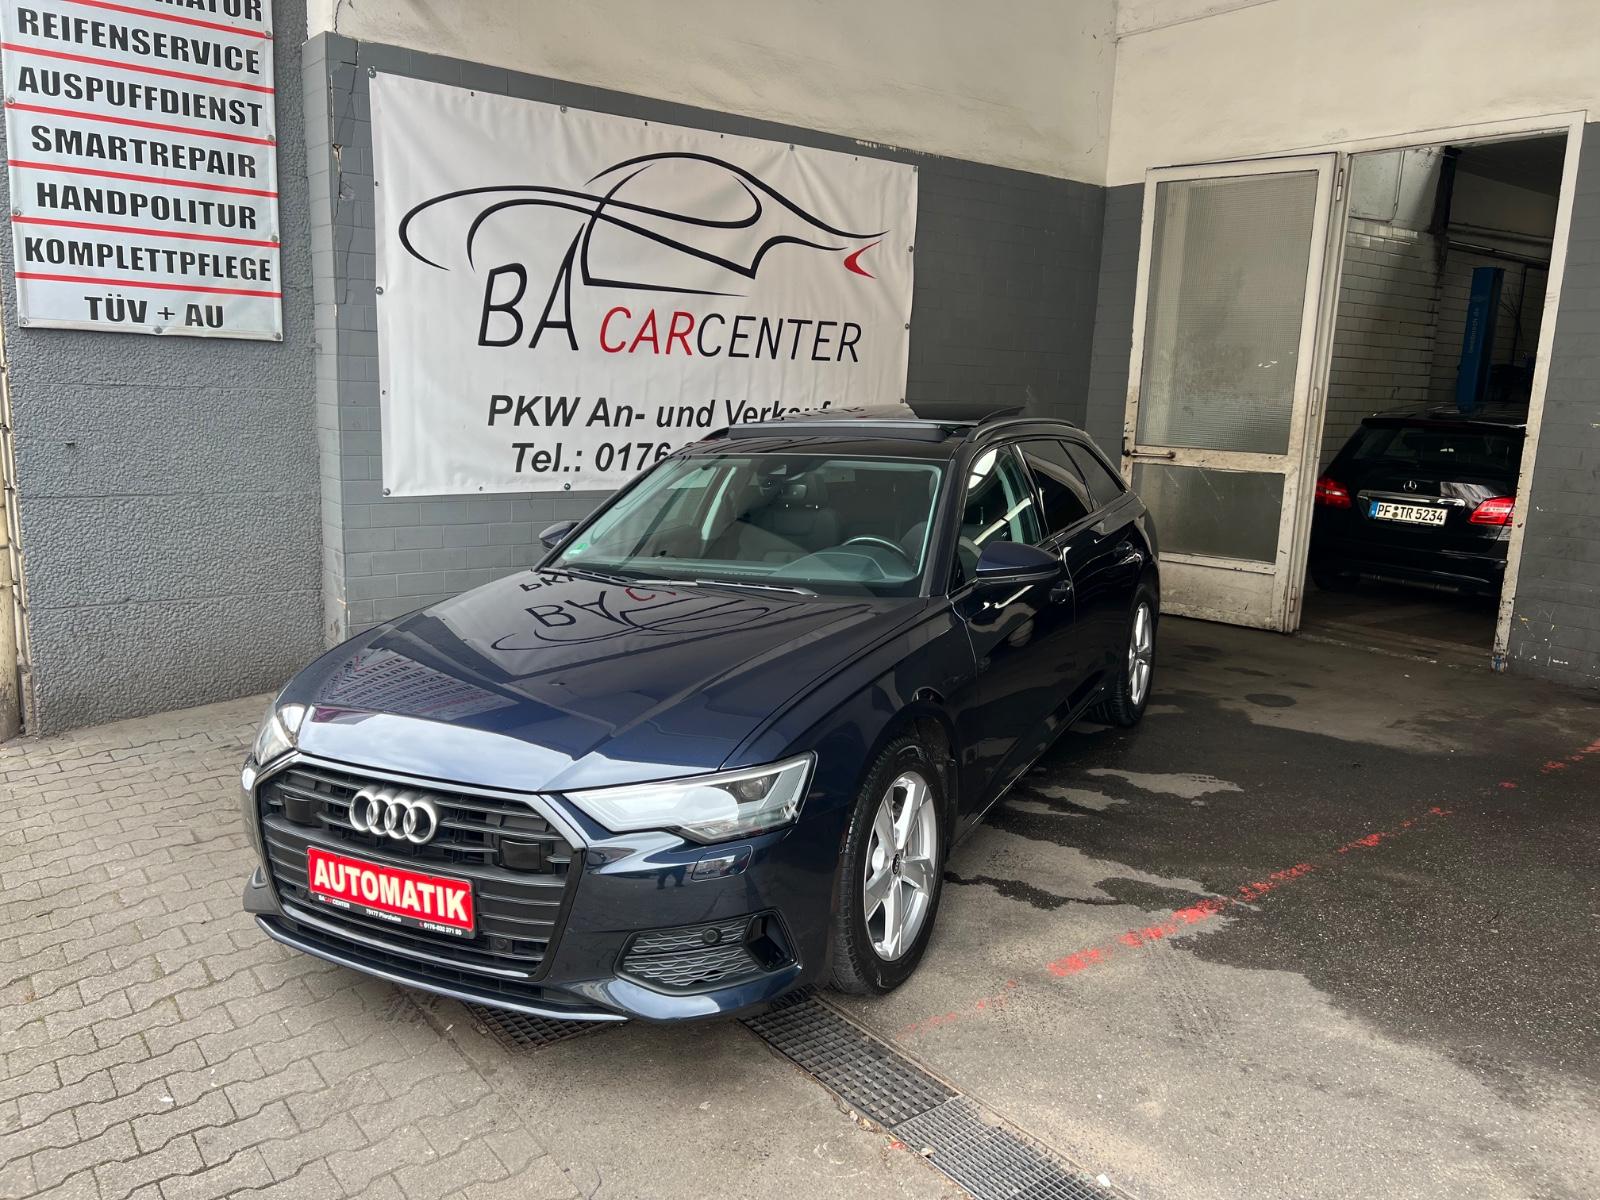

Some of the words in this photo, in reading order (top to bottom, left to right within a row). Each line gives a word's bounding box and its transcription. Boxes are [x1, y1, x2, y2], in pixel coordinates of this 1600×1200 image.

[17, 7, 260, 75] REIFENSERVICE
[18, 66, 263, 127] AUSPUFFDIENST
[31, 125, 256, 179] SMARTREPAIR
[36, 182, 257, 230] HANDPOLITUR
[24, 237, 271, 282] KOMPLETTPFLEGE
[84, 293, 148, 324] TÜV
[185, 303, 224, 329] AU
[599, 306, 863, 363] CARCENTER
[487, 394, 580, 428] PKW
[586, 397, 646, 428] An-
[655, 399, 716, 428] und
[511, 442, 583, 473] Tel.:
[594, 441, 672, 472] 0176
[1415, 508, 1444, 523] 5234
[314, 858, 469, 922] AUTOMATIK
